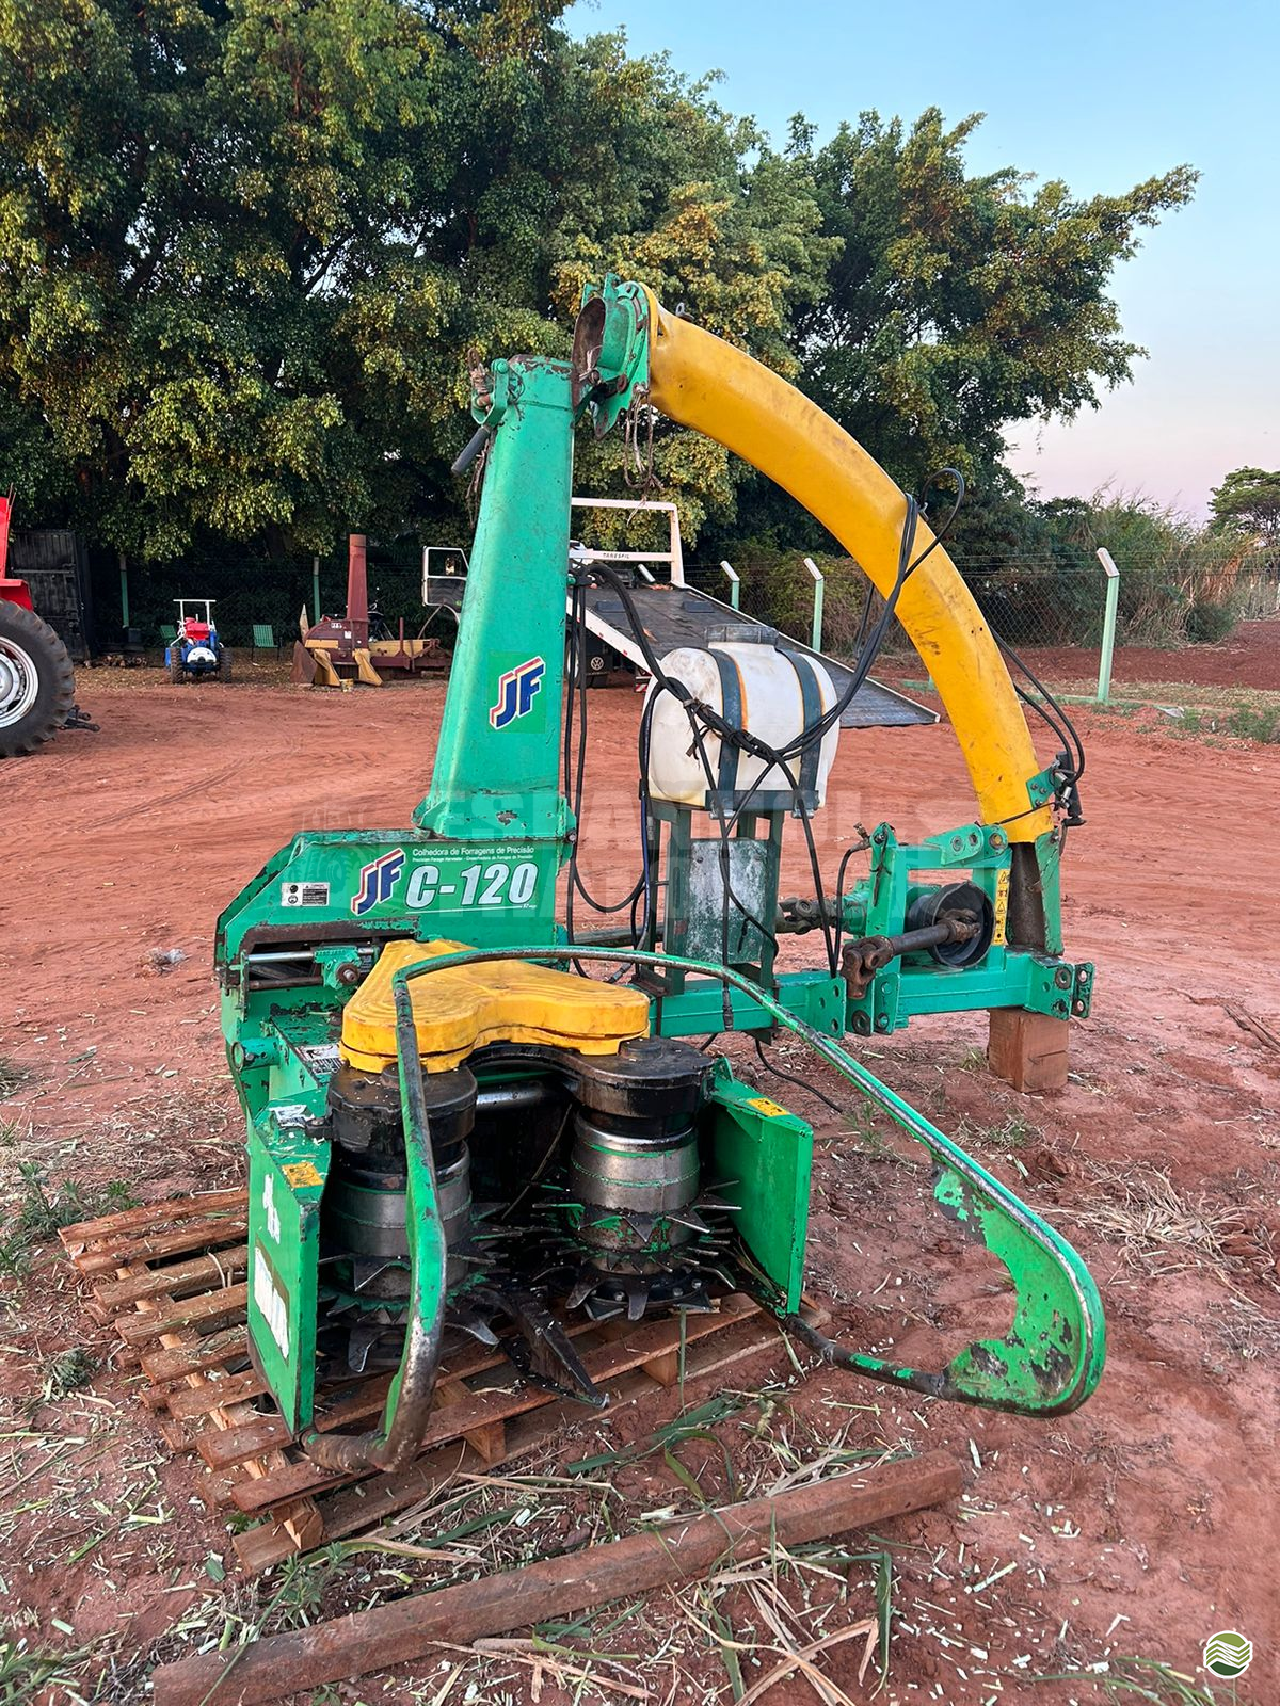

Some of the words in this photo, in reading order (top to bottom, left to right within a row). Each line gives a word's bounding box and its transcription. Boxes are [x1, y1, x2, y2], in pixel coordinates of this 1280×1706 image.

[490, 656, 546, 730] JF
[412, 848, 449, 857] Colhedora
[450, 847, 461, 856] de
[461, 847, 495, 856] Forragens
[496, 846, 506, 854] de
[507, 845, 535, 854] Precisão
[350, 848, 406, 917] JF
[405, 863, 539, 908] C-120
